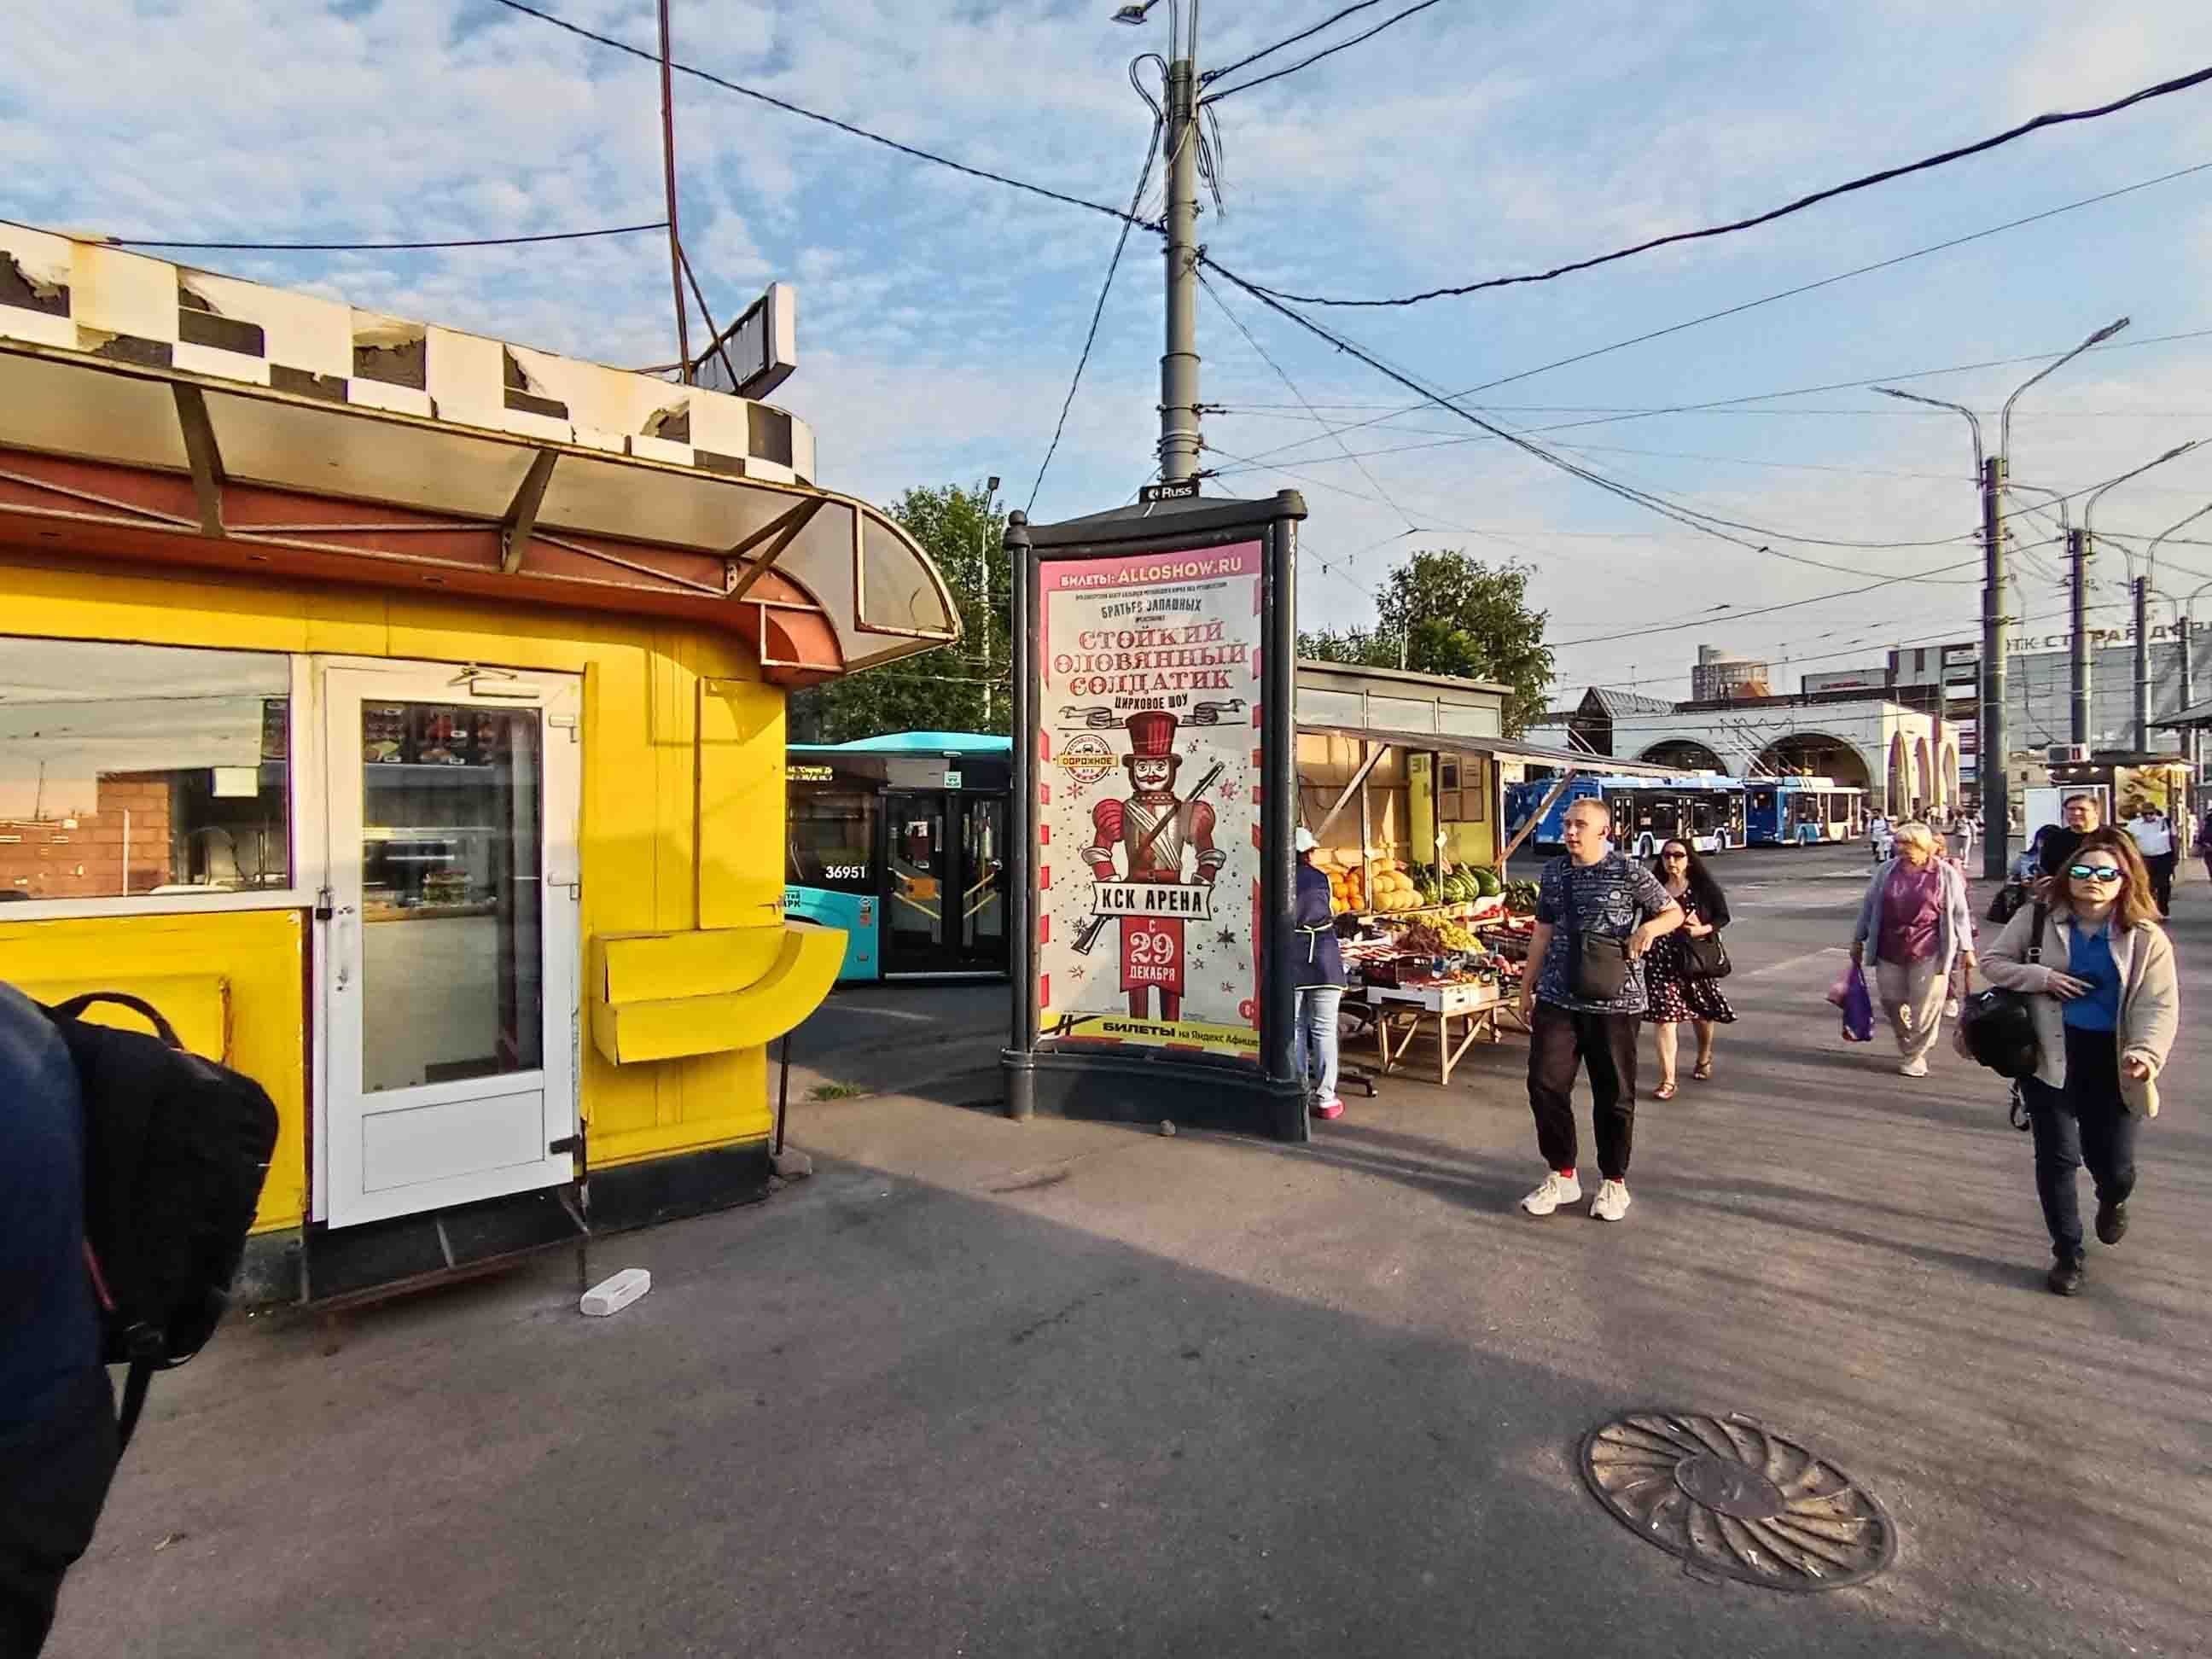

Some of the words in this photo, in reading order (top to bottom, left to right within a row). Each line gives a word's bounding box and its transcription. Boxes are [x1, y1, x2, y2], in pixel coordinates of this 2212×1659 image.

[1161, 486, 1192, 498] Russ
[1060, 573, 1115, 587] БИЛЕТЫ:
[1117, 556, 1243, 584] ALLOSHOW.RU
[1079, 617, 1225, 650] СТОЙКИЙ
[1053, 638, 1249, 674] ОЛОВЯННЫЙ
[1068, 669, 1234, 696] СОЛДАТИК
[1115, 697, 1165, 709] ЦИРКОВОЕ
[1168, 693, 1188, 708] ШОУ
[825, 865, 865, 879] 36951
[1102, 888, 1136, 910] КСК
[1145, 890, 1202, 913] АРЕНА
[1129, 933, 1174, 964] 29
[1129, 964, 1175, 982] ДЕКАБРЯ
[1103, 1022, 1175, 1038] БИЛЕТЫ
[1179, 1030, 1189, 1039] на
[1191, 1029, 1224, 1044] Яндекс
